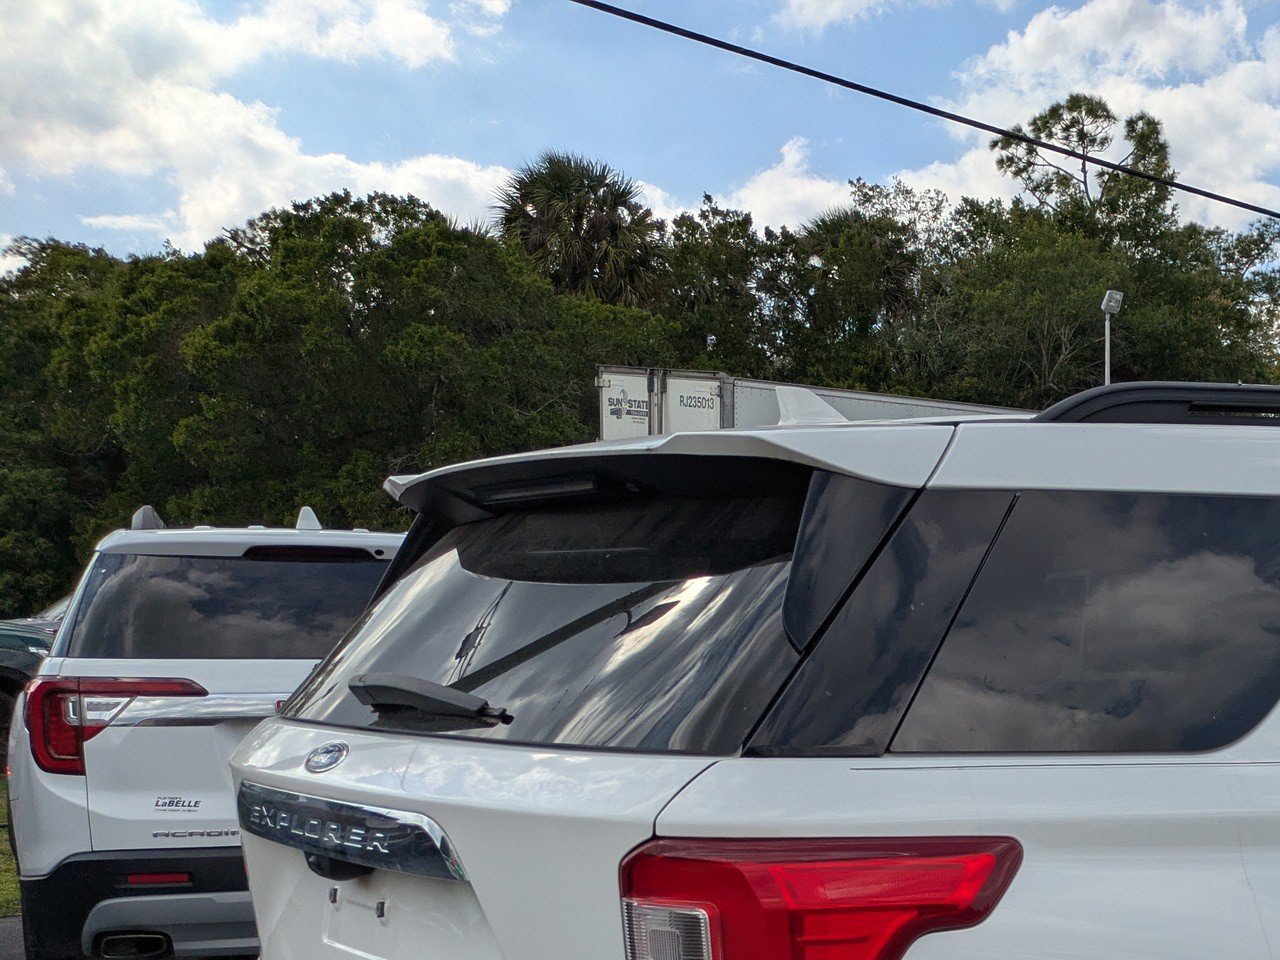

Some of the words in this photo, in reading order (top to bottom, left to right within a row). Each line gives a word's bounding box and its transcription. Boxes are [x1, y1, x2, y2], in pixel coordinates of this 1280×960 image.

[608, 397, 623, 408] SUN
[628, 399, 649, 409] STATE
[679, 395, 715, 410] RJ235013
[155, 800, 201, 808] LaBELLE
[249, 804, 390, 854] EXPLORER
